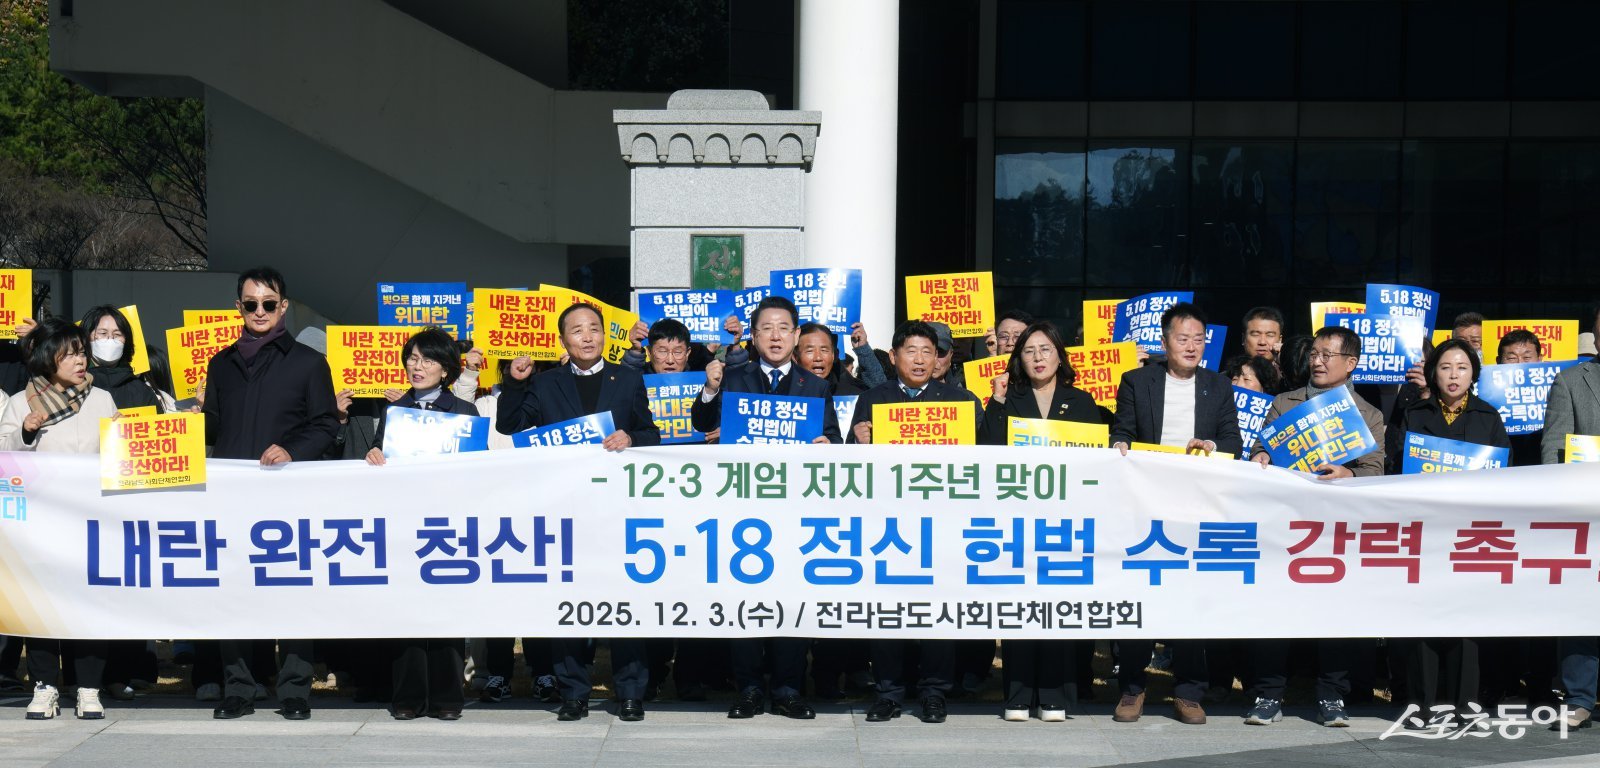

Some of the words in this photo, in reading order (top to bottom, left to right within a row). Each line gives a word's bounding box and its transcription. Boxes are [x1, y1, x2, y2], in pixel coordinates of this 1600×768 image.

[0, 274, 15, 291] 재
[784, 273, 814, 289] 5.18
[919, 279, 948, 295] 내란
[952, 277, 979, 293] 잔재
[383, 295, 410, 305] 빛으로
[412, 294, 431, 305] 함께
[433, 294, 462, 305] 지켜낸
[490, 294, 521, 312] 내란
[525, 295, 556, 312] 잔재
[653, 293, 684, 305] 5.18
[687, 292, 718, 304] 정신
[735, 290, 763, 308] 5.18
[794, 289, 838, 306] 헌법
[929, 294, 971, 311] 완전히
[1380, 289, 1409, 305] 5.18
[1411, 291, 1432, 310] 정신
[395, 306, 450, 324] 위대한
[664, 303, 709, 317] 헌법에
[798, 306, 847, 323] 록하라!
[1126, 299, 1148, 318] 5.18
[499, 312, 546, 331] 완전히
[181, 330, 210, 348] 내란
[342, 331, 374, 348] 내란
[488, 330, 556, 349] 청산하라!
[1360, 336, 1395, 354] 법에
[353, 350, 399, 367] 완전히
[1090, 348, 1120, 367] 잔재
[1358, 354, 1405, 372] 록하라!
[342, 367, 411, 385] 청산하라
[979, 360, 1007, 378] 내란
[659, 386, 680, 398] 함께
[683, 384, 704, 396] 지켜
[738, 398, 772, 417] 5.18
[775, 401, 808, 420] 정신
[889, 408, 920, 423] 내란
[926, 406, 958, 422] 잔재
[117, 421, 150, 440] 내란
[154, 418, 187, 437] 잔재
[747, 418, 796, 438] 헌법에
[899, 423, 947, 439] 완전히
[1237, 411, 1266, 433] 법에
[1268, 424, 1299, 451] 빛으로
[1296, 412, 1319, 431] 함께
[1320, 399, 1351, 419] 지켜낸
[564, 421, 600, 442] 정신
[1287, 416, 1346, 457] 위대한
[128, 438, 177, 457] 완전히
[1409, 446, 1441, 462] 빛으로
[1443, 452, 1466, 467] 함께
[118, 455, 190, 476] 청산하라!
[716, 463, 787, 498] 계엄
[802, 463, 873, 500] 저지
[891, 463, 980, 500] 1주년
[996, 463, 1067, 501] 맞이
[86, 519, 227, 588] 내란
[249, 517, 389, 587] 완전
[415, 516, 574, 585] 청산!
[799, 517, 934, 586] 정신
[962, 517, 1095, 586] 헌법
[1122, 519, 1261, 586] 수록
[1286, 520, 1424, 584] 강력
[1449, 520, 1600, 585] 촉구
[558, 601, 641, 626] 2025.
[655, 601, 697, 626] 12.
[709, 600, 784, 630] 3.(수)
[817, 600, 1143, 630] 전라남도사회단체연합회
